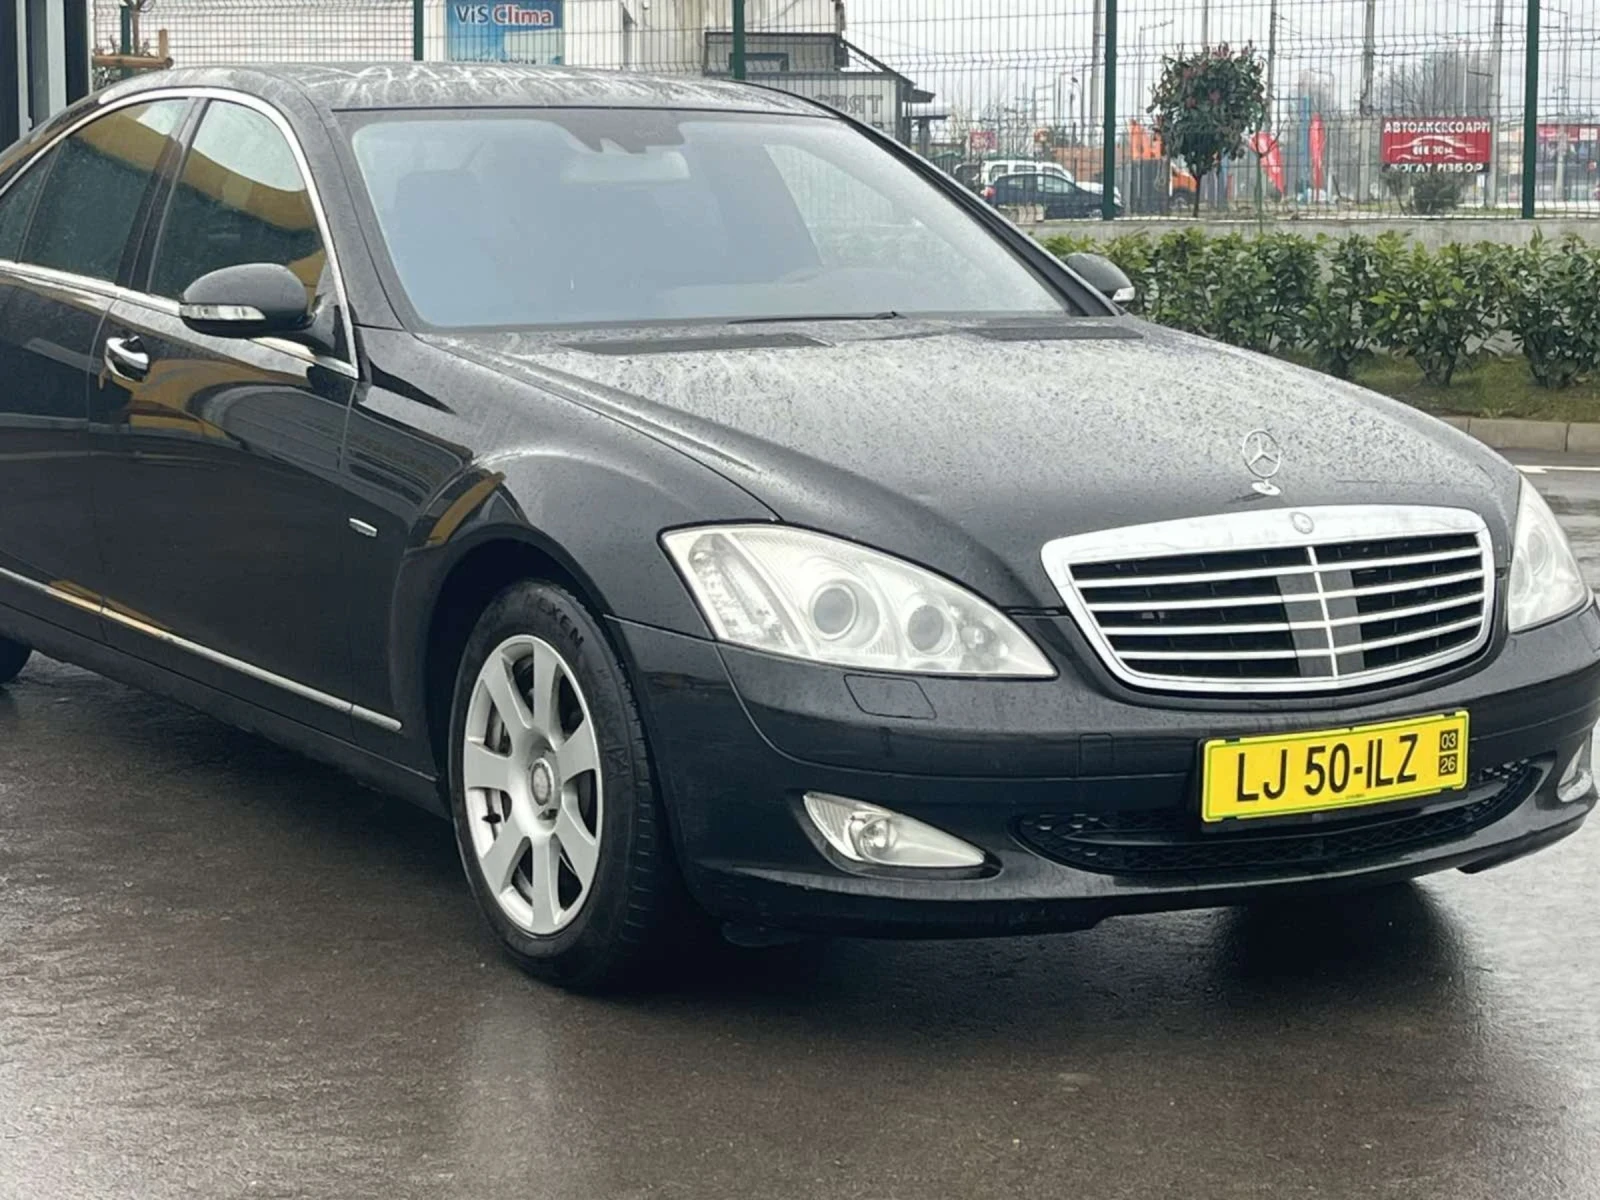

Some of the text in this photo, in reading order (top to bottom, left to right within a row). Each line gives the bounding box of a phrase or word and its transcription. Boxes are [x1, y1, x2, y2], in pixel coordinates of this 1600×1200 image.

[456, 4, 554, 25] ViS Clima
[1441, 732, 1457, 749] 03
[1236, 733, 1418, 802] LJ 50-ILZ
[1440, 755, 1456, 773] 26
